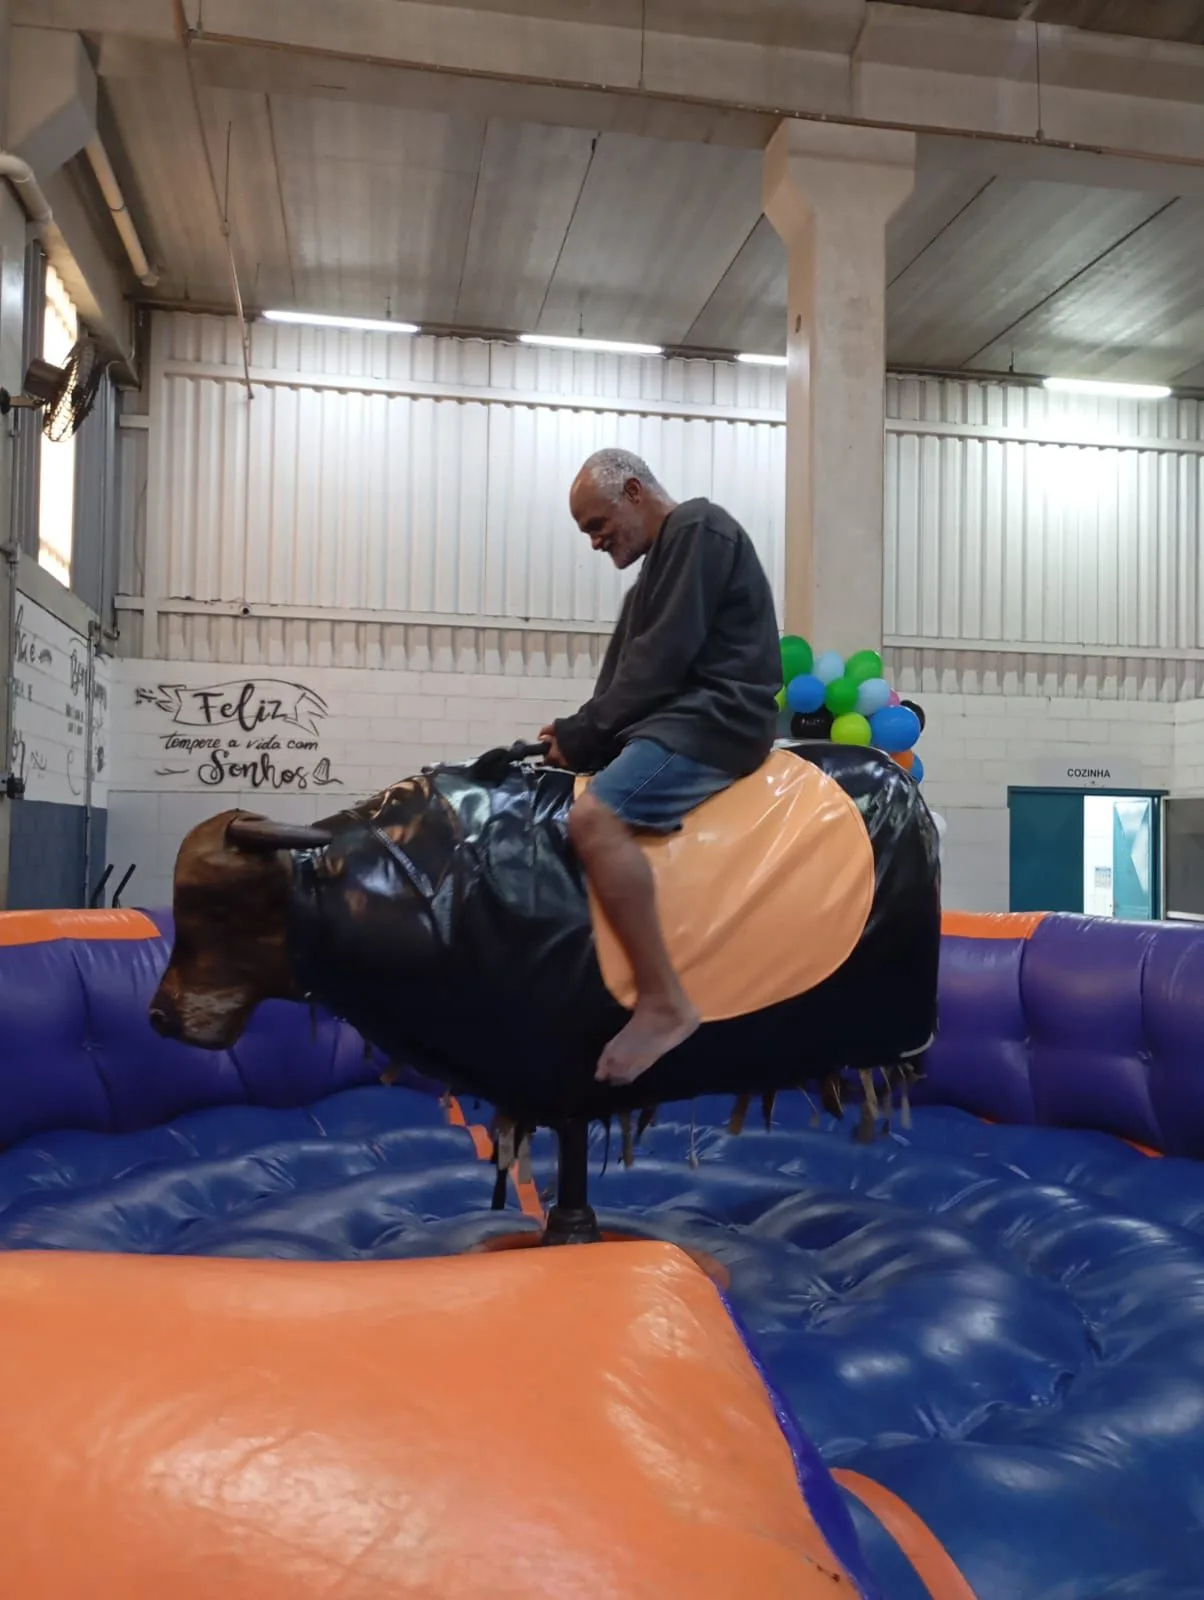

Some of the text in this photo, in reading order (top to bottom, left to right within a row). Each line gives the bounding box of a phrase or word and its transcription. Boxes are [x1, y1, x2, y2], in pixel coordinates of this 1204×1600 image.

[192, 683, 287, 732] Feliz
[228, 739, 239, 748] a
[246, 735, 281, 750] vida
[287, 741, 318, 751] com
[198, 749, 308, 789] Sonhos
[1067, 768, 1111, 778] COZINHA
